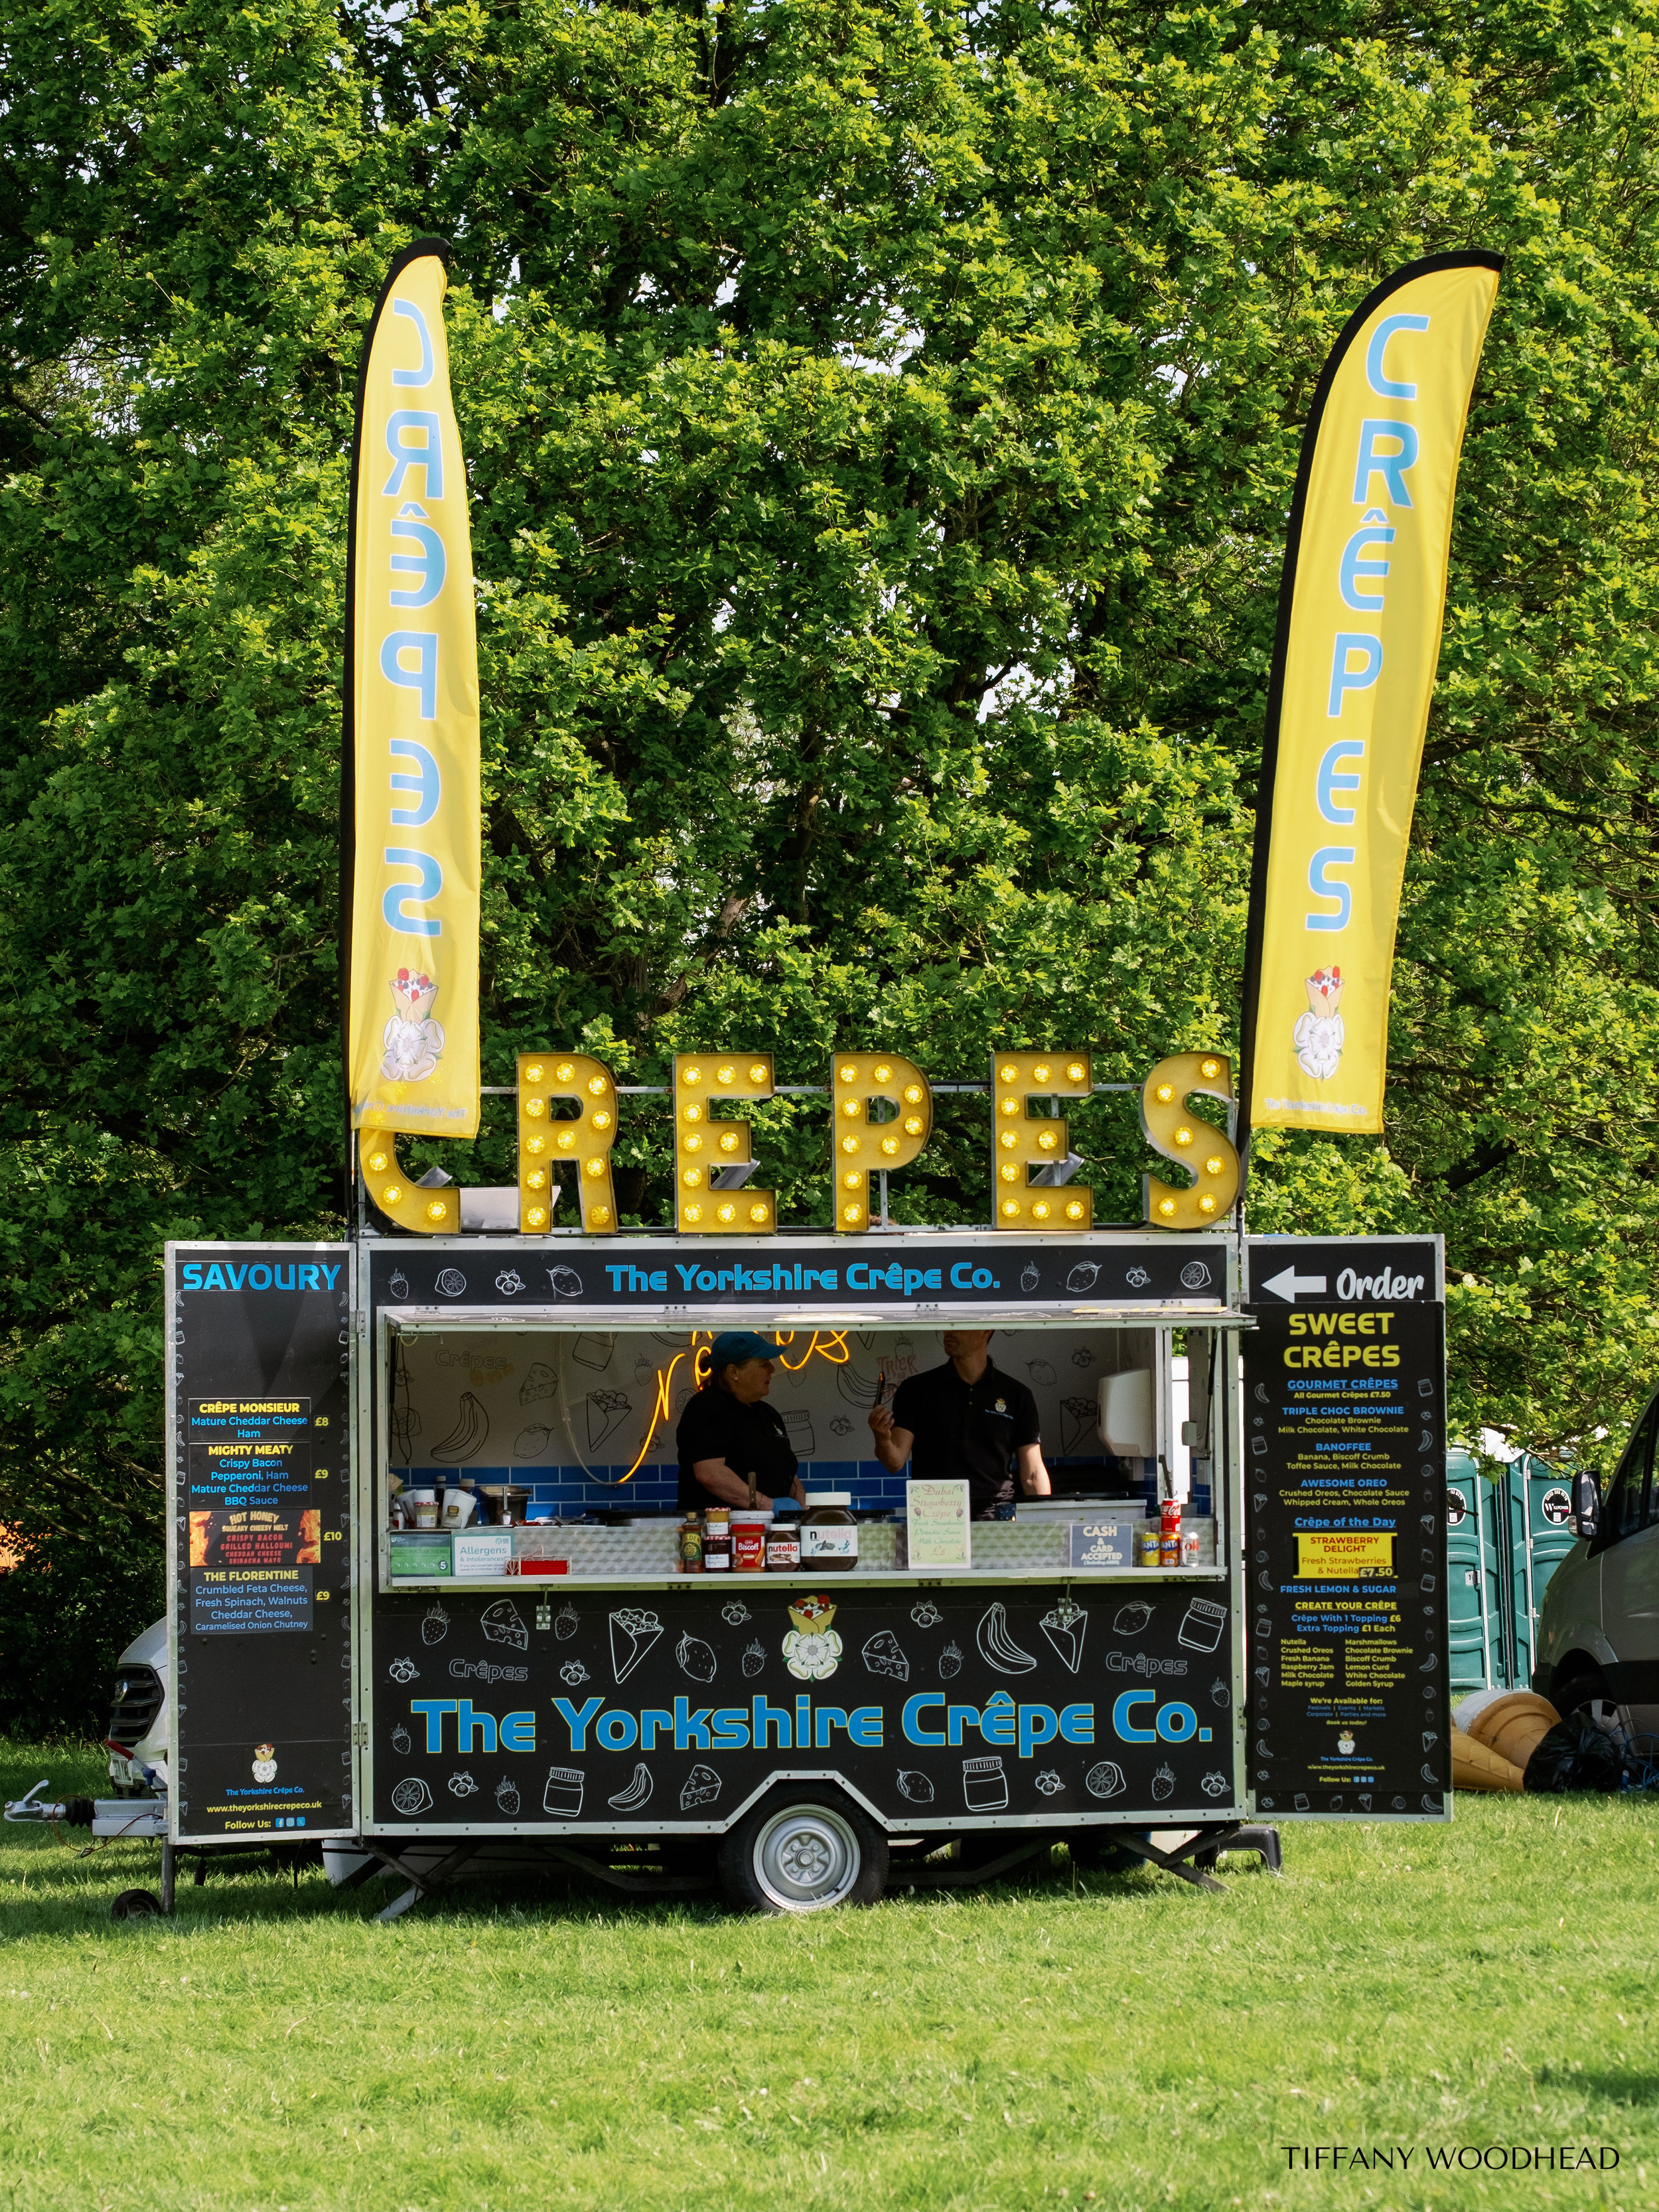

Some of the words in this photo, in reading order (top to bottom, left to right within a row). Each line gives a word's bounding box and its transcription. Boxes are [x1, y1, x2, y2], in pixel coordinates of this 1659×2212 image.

[1305, 313, 1430, 930] CRÊPES
[182, 1264, 341, 1290] SAVOURY
[606, 1265, 667, 1291] The
[675, 1264, 837, 1291] Yorkshire
[846, 1263, 941, 1295] Crêpe
[951, 1262, 1000, 1288] Co.
[1337, 1266, 1424, 1300] Order
[1289, 1313, 1394, 1335] SWEET
[1284, 1341, 1400, 1367] CRÊPES
[435, 1350, 507, 1372] Crêpes
[1288, 1380, 1347, 1389] GOURMET
[1351, 1377, 1398, 1388] CRÊPES
[199, 1402, 237, 1413] CRÊPE
[240, 1403, 299, 1413] MONSIEUR
[192, 1417, 226, 1425] Mature
[229, 1416, 270, 1425] Cheddar
[273, 1416, 307, 1425] Cheese
[315, 1417, 328, 1426] £8
[238, 1429, 260, 1438] Ham
[209, 1445, 252, 1455] MIGHTY
[255, 1445, 293, 1455] MEATY
[220, 1458, 250, 1469] Crispy
[252, 1459, 282, 1467] Bacon
[211, 1471, 263, 1482] Pepperoni,
[315, 1469, 328, 1478] £9
[192, 1485, 226, 1493] Mature
[229, 1483, 270, 1492] Cheddar
[273, 1483, 308, 1491] Cheese
[922, 1485, 954, 1495] Dubai
[225, 1497, 247, 1506] BBQ
[910, 1496, 962, 1509] Strawberry
[229, 1512, 247, 1525] HOT
[250, 1511, 280, 1523] HONEY
[1295, 1517, 1330, 1528] Crêpe
[1334, 1517, 1345, 1526] of
[1349, 1517, 1369, 1526] the
[1373, 1517, 1396, 1528] Day
[324, 1532, 342, 1541] £10
[1083, 1526, 1117, 1537] CASH
[460, 1546, 506, 1556] Allergens
[768, 1544, 798, 1552] nutella
[441, 1561, 446, 1570] 5
[204, 1572, 226, 1581] THE
[229, 1570, 298, 1581] FLORENTINE
[1360, 1568, 1393, 1577] £7.50
[196, 1585, 243, 1594] Crumbled
[270, 1584, 307, 1593] Cheese,
[316, 1591, 329, 1600] £9
[196, 1598, 222, 1607] Fresh
[225, 1597, 265, 1607] Spinach,
[268, 1597, 307, 1605] Walnuts
[1365, 1600, 1397, 1609] CRÊPE
[211, 1610, 252, 1619] Cheddar
[255, 1610, 292, 1618] Cheese,
[1292, 1615, 1318, 1623] Crêpe
[1351, 1614, 1387, 1623] Topping
[196, 1622, 245, 1630] Caramelised
[1323, 1625, 1359, 1633] Topping
[1106, 1652, 1187, 1678] Crêpes
[449, 1659, 528, 1683] Crêpes
[411, 1699, 535, 1753] The
[551, 1695, 883, 1752] Yorkshire
[902, 1691, 1094, 1759] Crêpe
[1113, 1689, 1215, 1743] Co.
[225, 1821, 255, 1829] Follow
